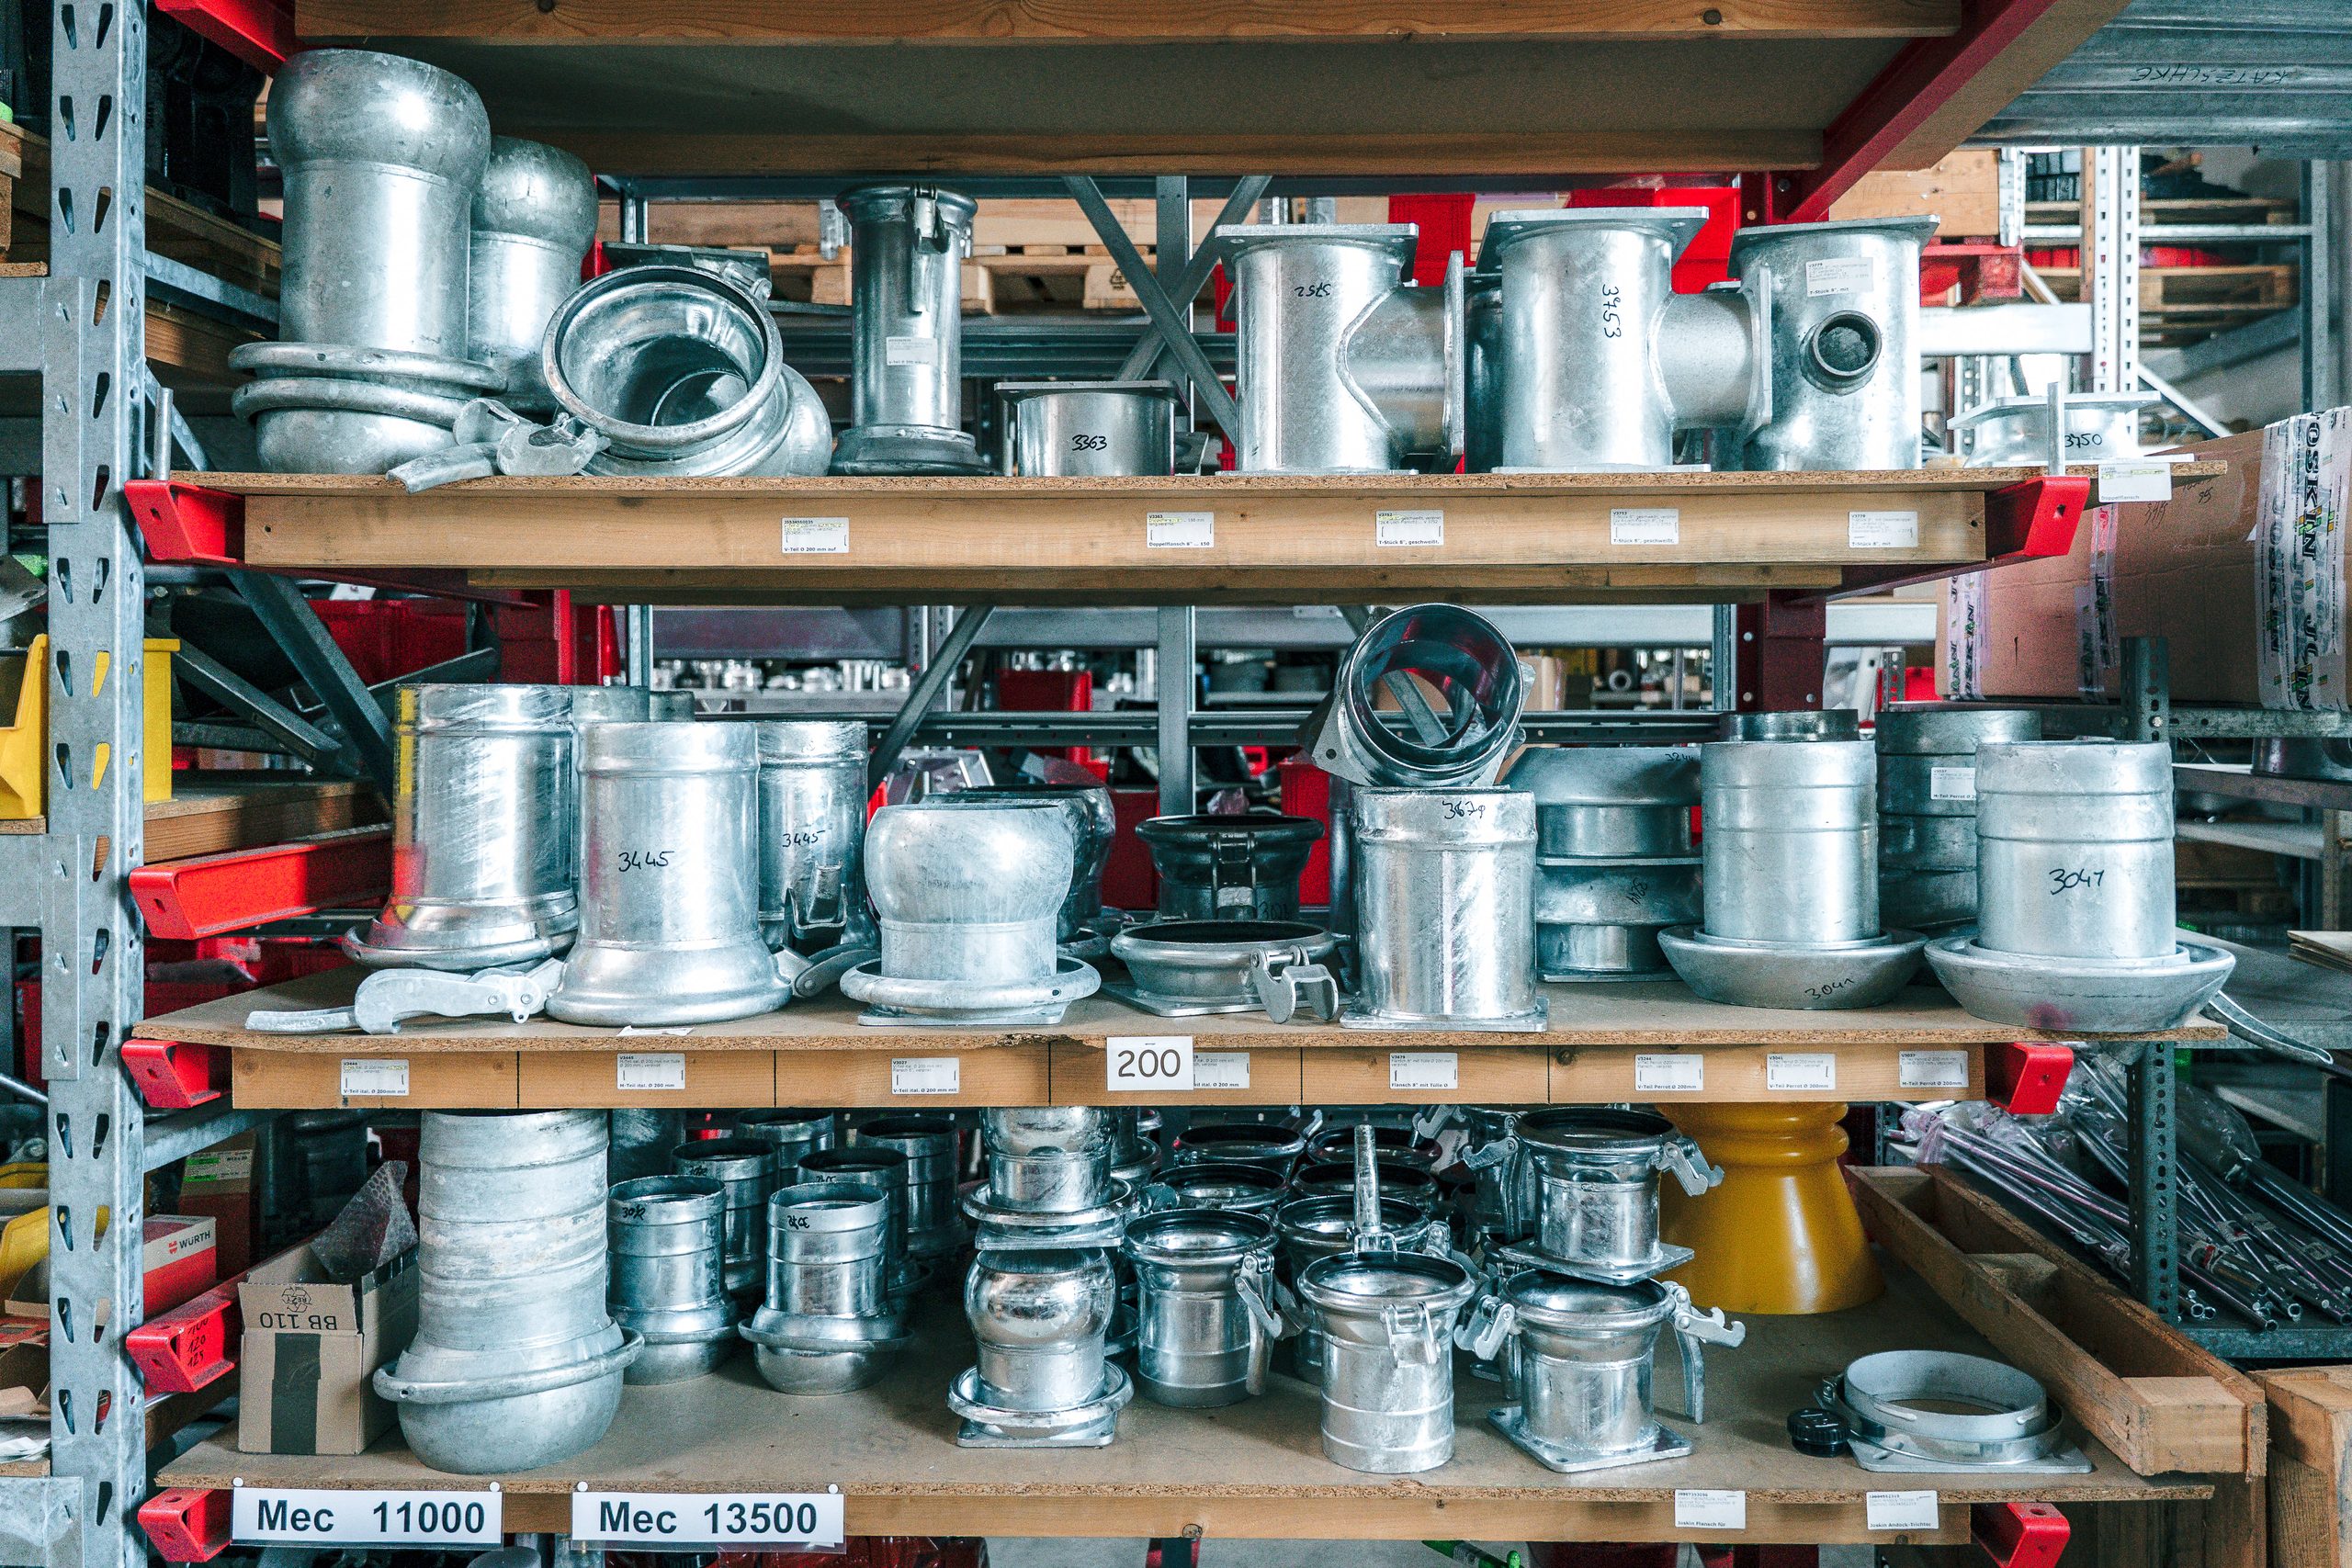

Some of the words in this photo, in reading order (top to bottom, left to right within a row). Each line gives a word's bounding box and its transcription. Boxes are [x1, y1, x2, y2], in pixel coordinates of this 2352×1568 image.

[1071, 434, 1107, 451] 3363
[2064, 433, 2103, 448] 3750
[782, 829, 826, 847] 3445
[618, 851, 675, 873] 3445
[1117, 1049, 1181, 1077] 200
[179, 1230, 210, 1248] WÜRTH
[259, 1313, 300, 1329] 110
[309, 1314, 338, 1330] BB
[258, 1500, 335, 1533] Mec
[372, 1501, 485, 1534] 11000
[599, 1501, 678, 1534] Mec
[703, 1502, 818, 1535] 13500
